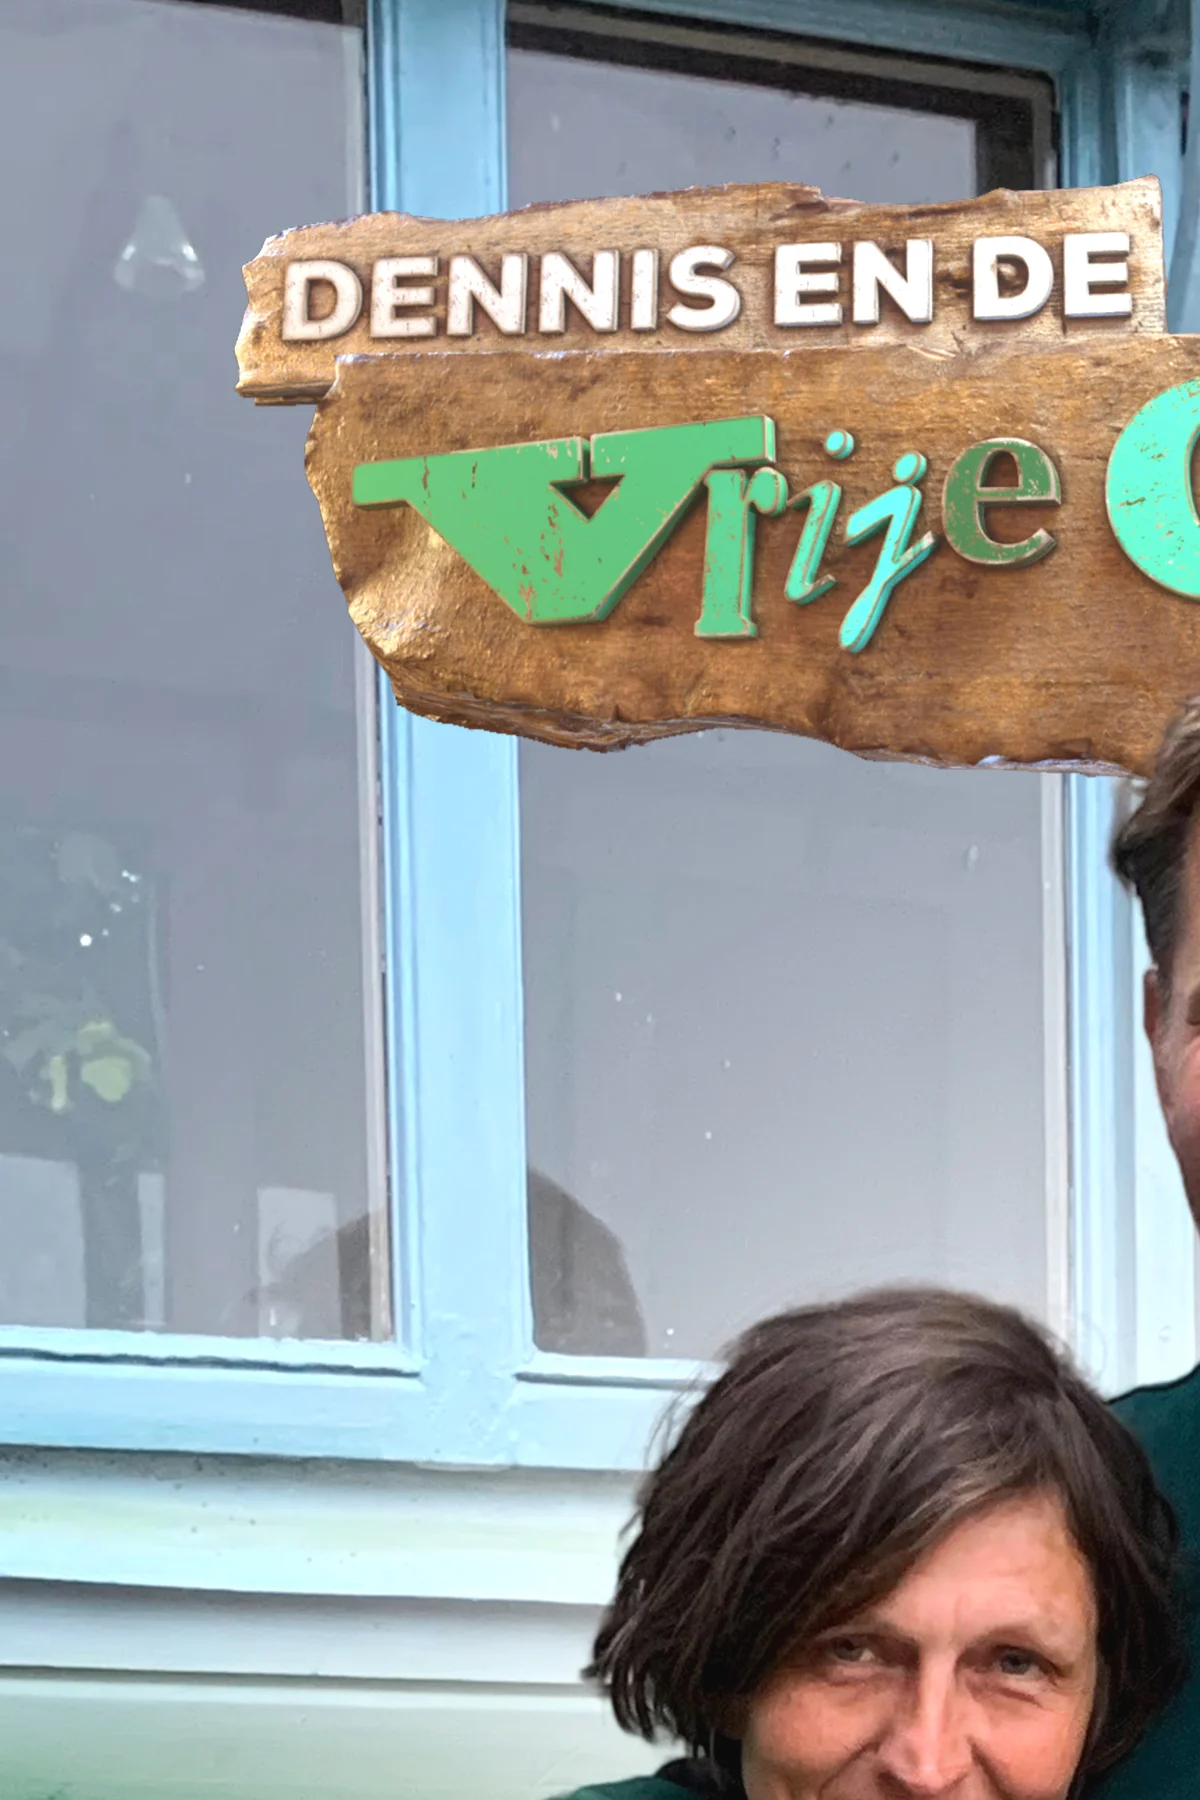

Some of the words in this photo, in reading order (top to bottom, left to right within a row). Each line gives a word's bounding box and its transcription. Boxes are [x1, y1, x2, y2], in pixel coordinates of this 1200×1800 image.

[281, 244, 743, 341] DENNIS
[773, 237, 934, 328] EN
[970, 231, 1133, 322] DE
[352, 415, 1062, 653] Vrije
